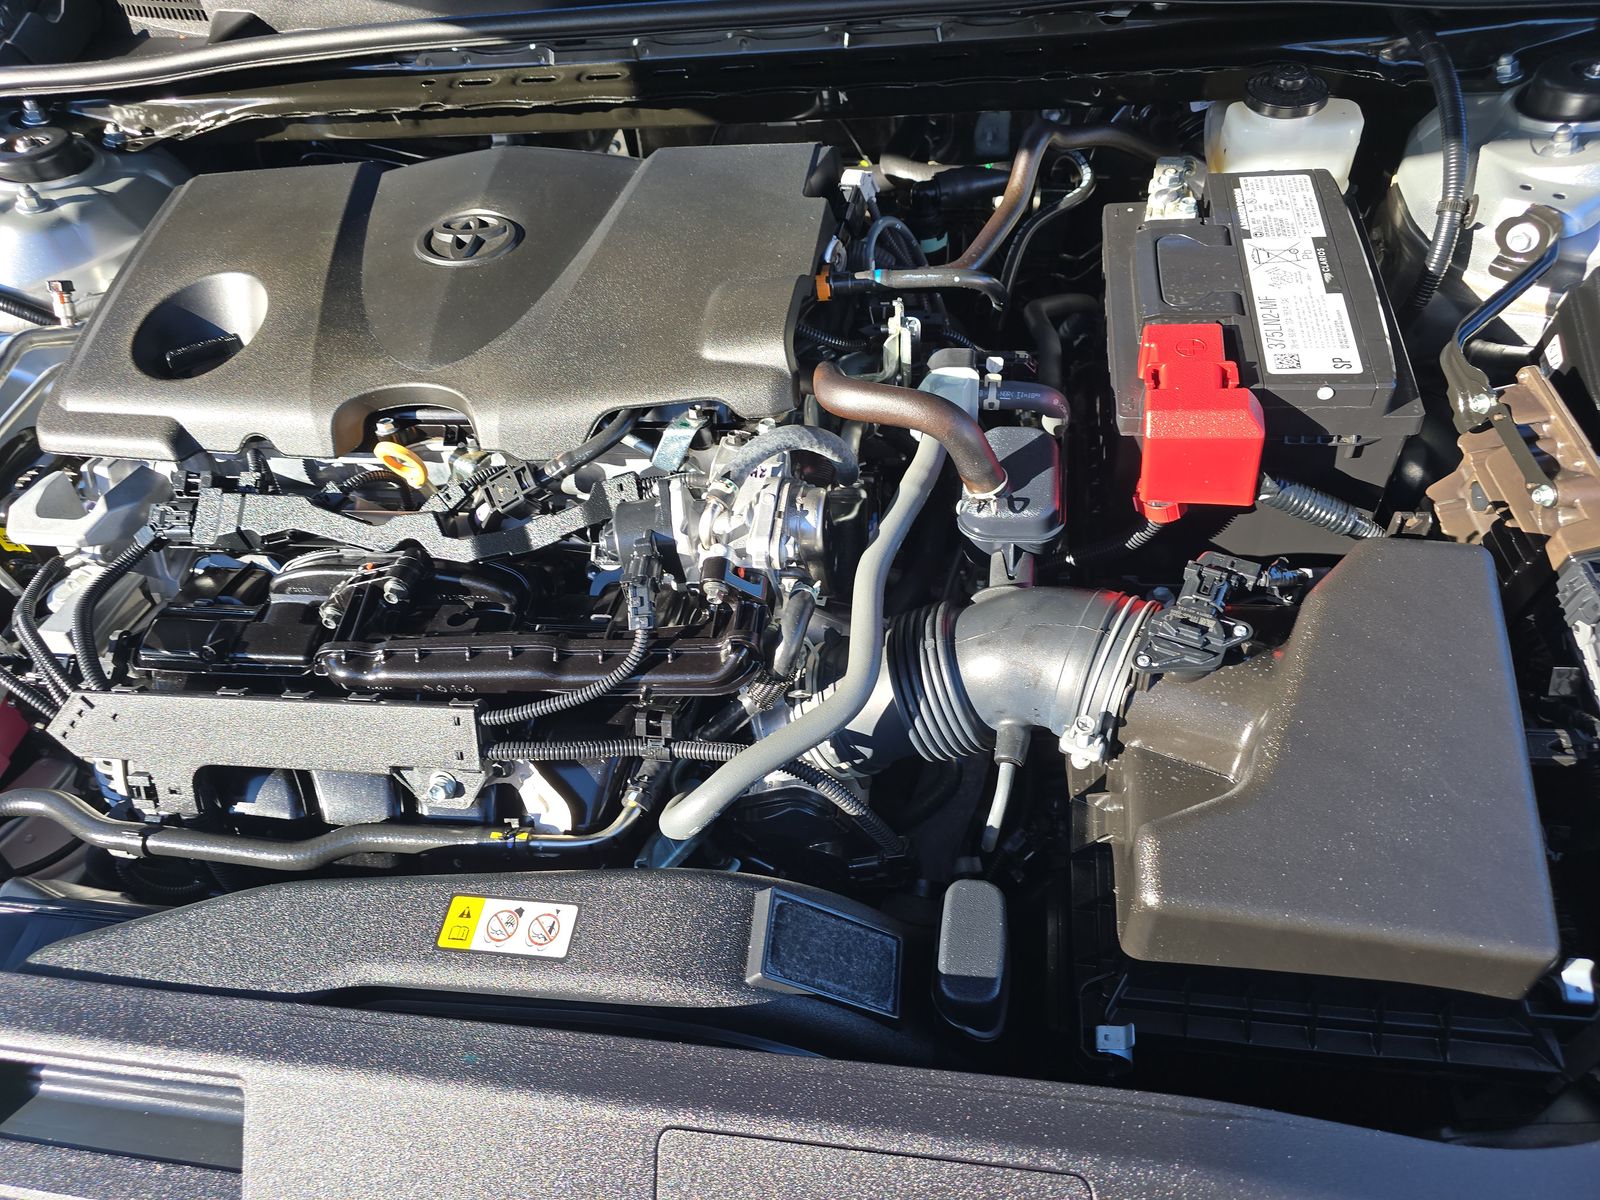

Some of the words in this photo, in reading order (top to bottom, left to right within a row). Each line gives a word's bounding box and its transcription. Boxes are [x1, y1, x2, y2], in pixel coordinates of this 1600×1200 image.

[1301, 249, 1314, 260] Pb
[1316, 247, 1331, 272] CLARIOS
[1257, 296, 1286, 350] 375LN2-MF
[1331, 357, 1353, 370] SP
